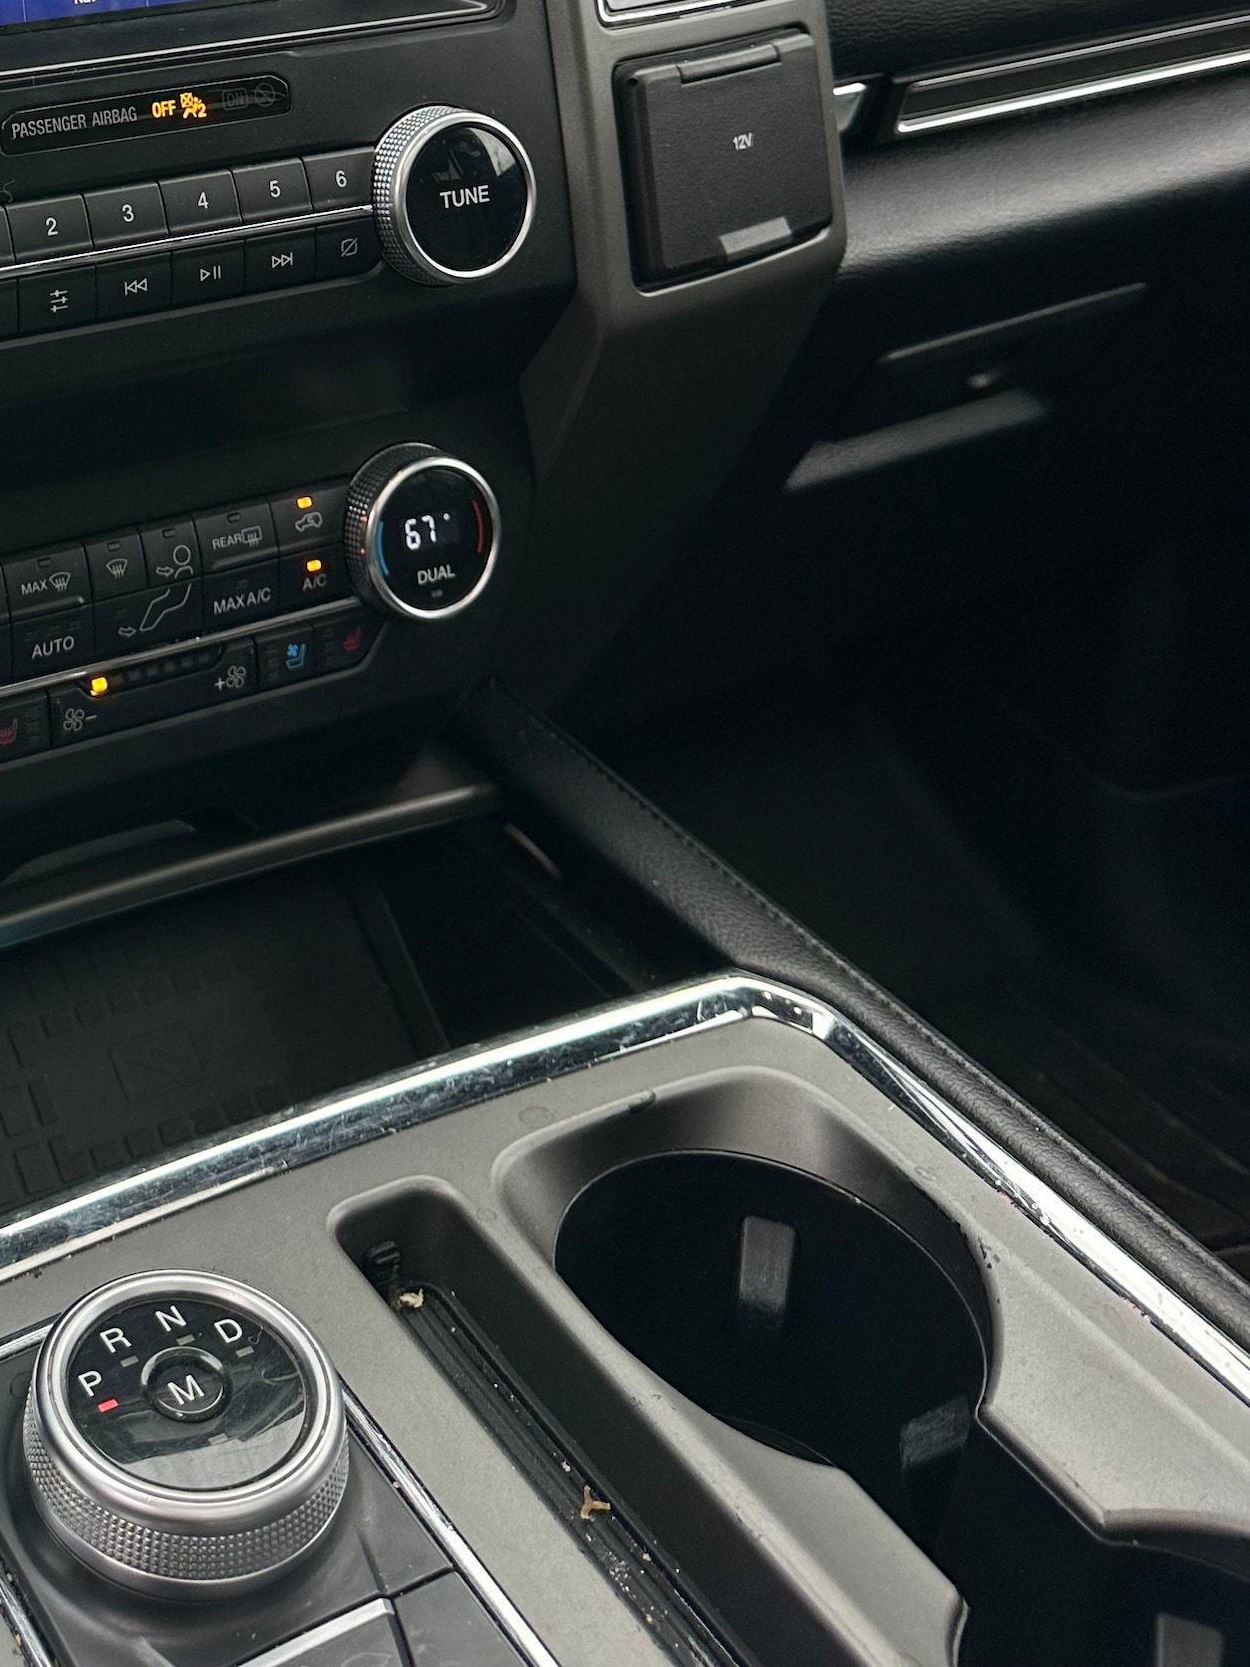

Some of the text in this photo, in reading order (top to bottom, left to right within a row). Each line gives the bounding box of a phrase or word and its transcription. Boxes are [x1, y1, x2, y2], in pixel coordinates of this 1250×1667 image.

[11, 113, 87, 140] PASSENGER
[91, 106, 138, 128] AIRBAG
[152, 99, 177, 119] OFF
[732, 132, 754, 151] 12V
[335, 170, 347, 188] 6
[269, 180, 281, 199] 5
[440, 185, 490, 210] TUNE
[198, 192, 209, 210] 4
[122, 203, 136, 223] 3
[45, 217, 59, 237] 2
[211, 529, 242, 550] REAR
[303, 573, 327, 592] A/C
[417, 564, 456, 585] DUAL
[21, 579, 49, 596] MAX
[31, 636, 75, 659] AUTO
[100, 1305, 243, 1354] R N D
[77, 1370, 103, 1397] P
[167, 1374, 205, 1405] M
